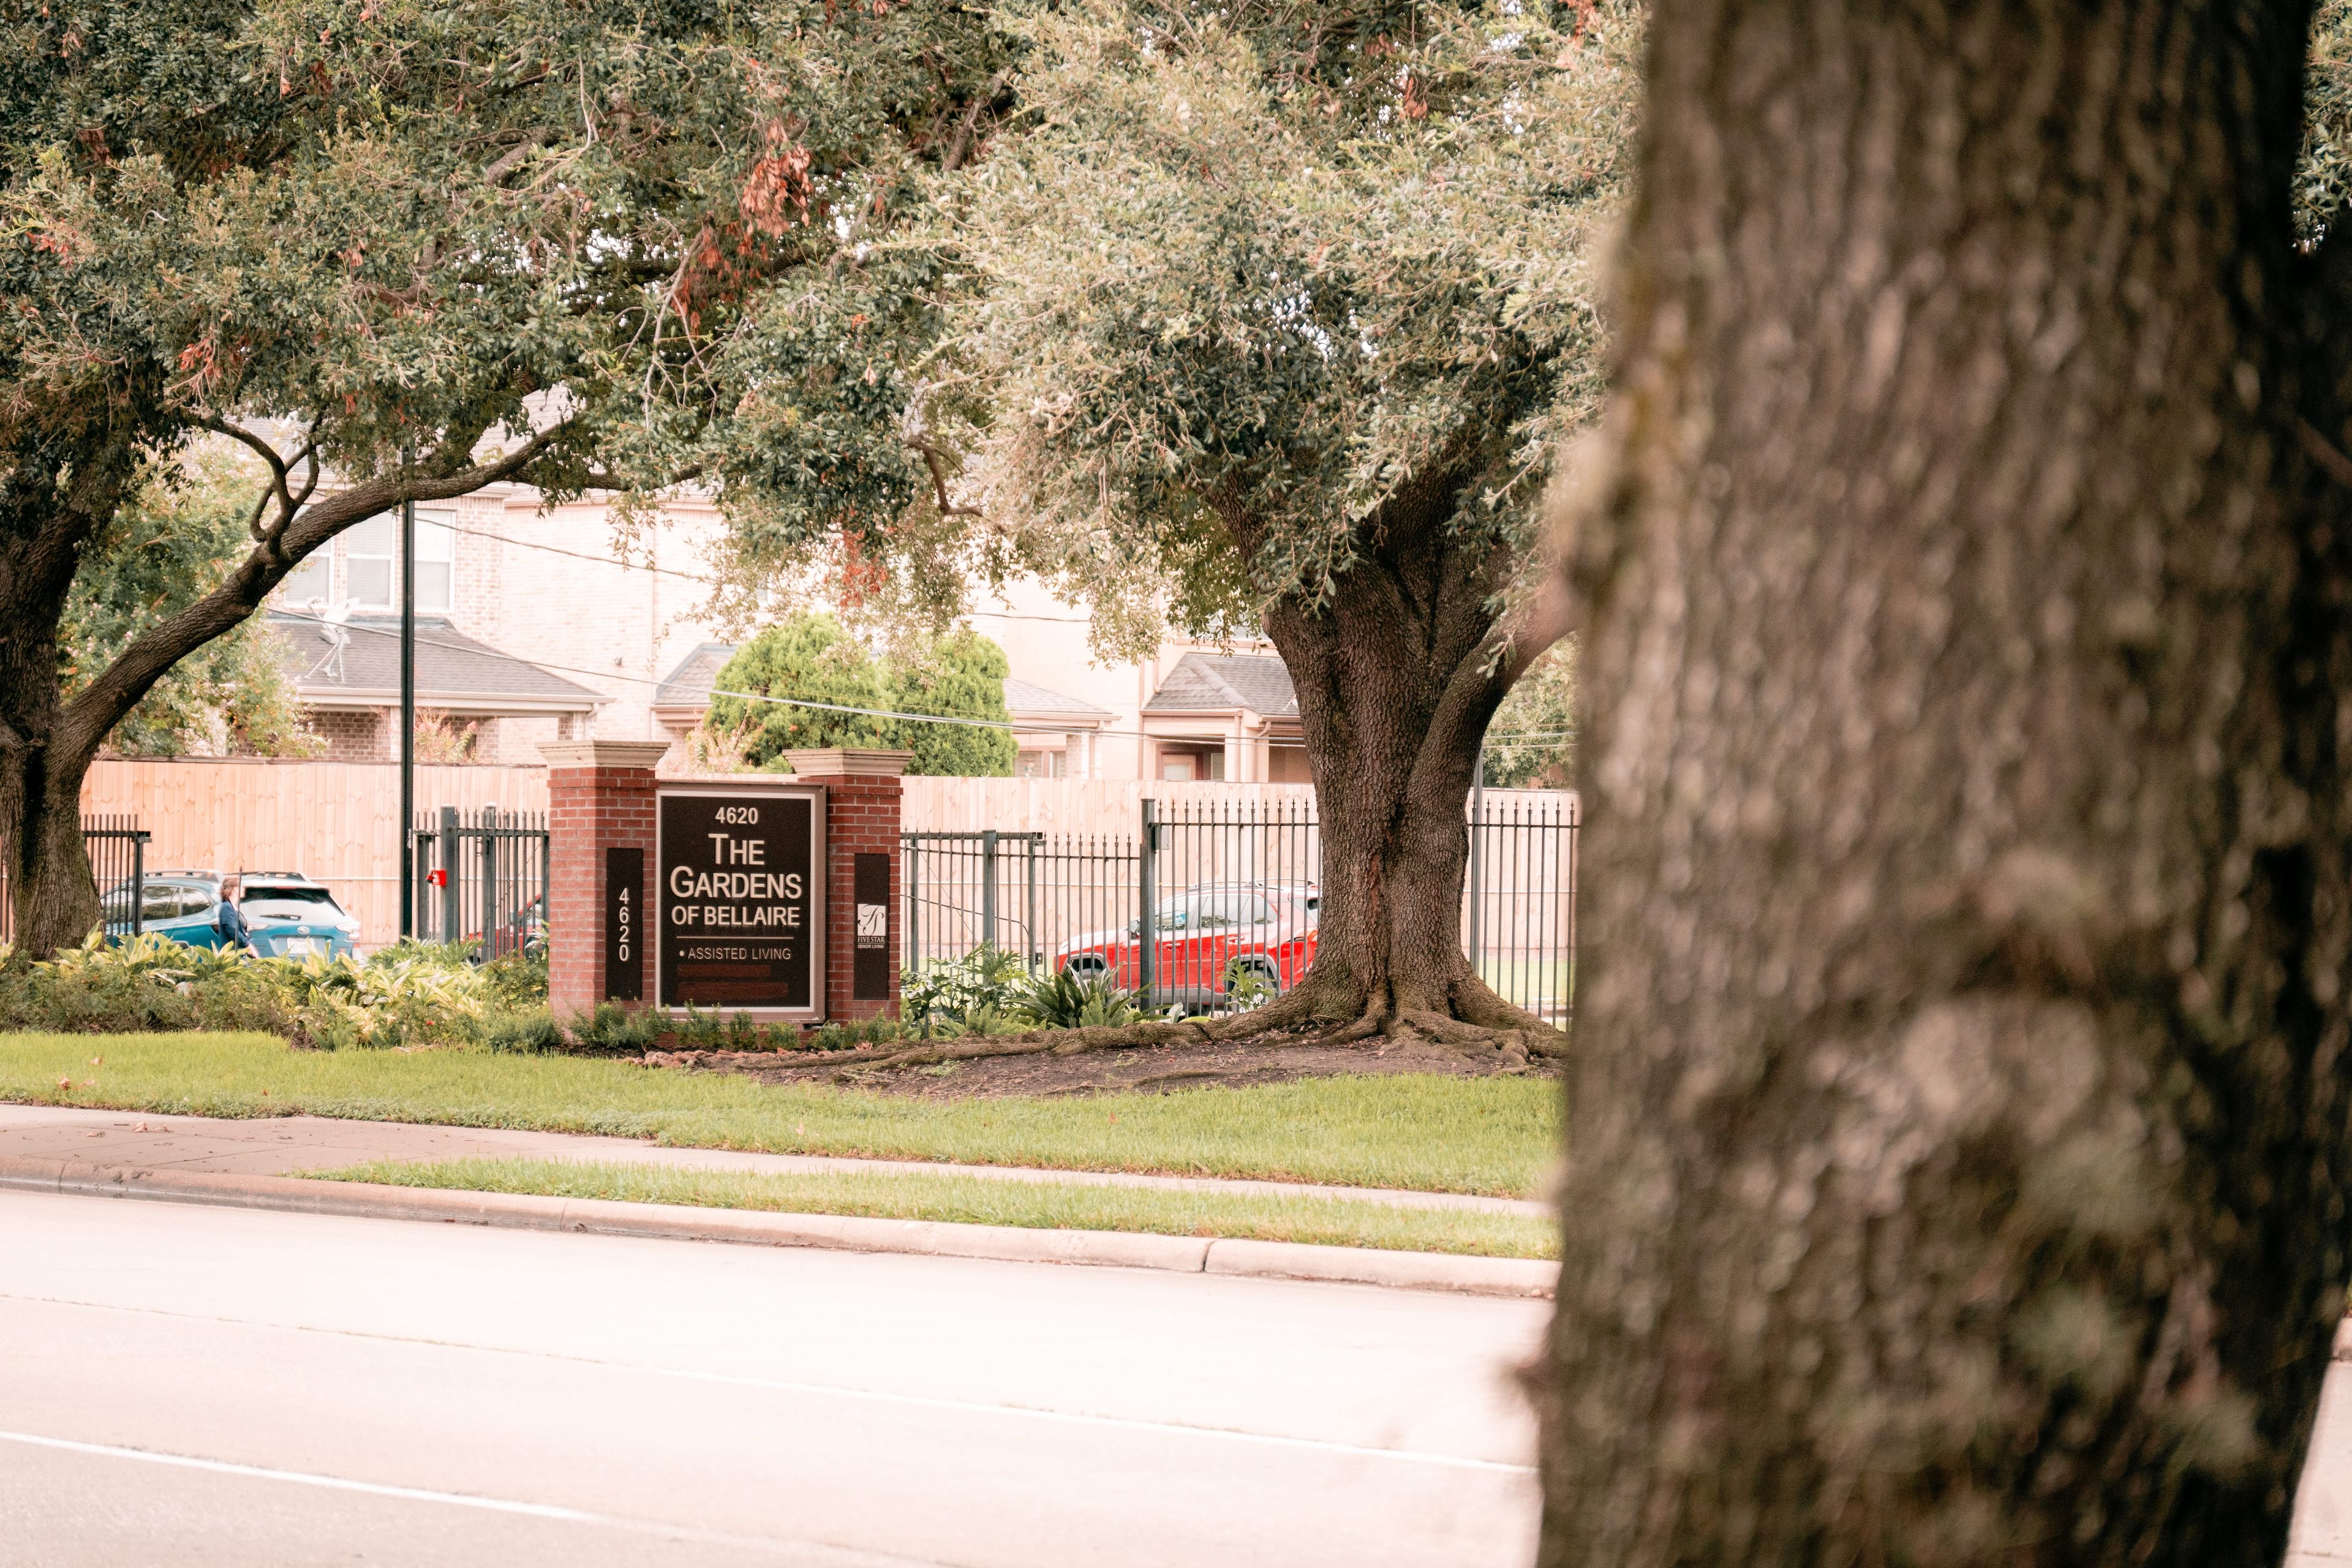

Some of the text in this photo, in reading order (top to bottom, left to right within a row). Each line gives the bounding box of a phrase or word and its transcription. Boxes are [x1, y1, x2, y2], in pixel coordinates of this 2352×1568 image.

[715, 807, 758, 824] 4620
[707, 833, 765, 865] THE
[669, 865, 802, 899] GARDENS
[671, 905, 800, 926] OF BELLAIRE
[688, 948, 791, 960] ASSISTED LIVING
